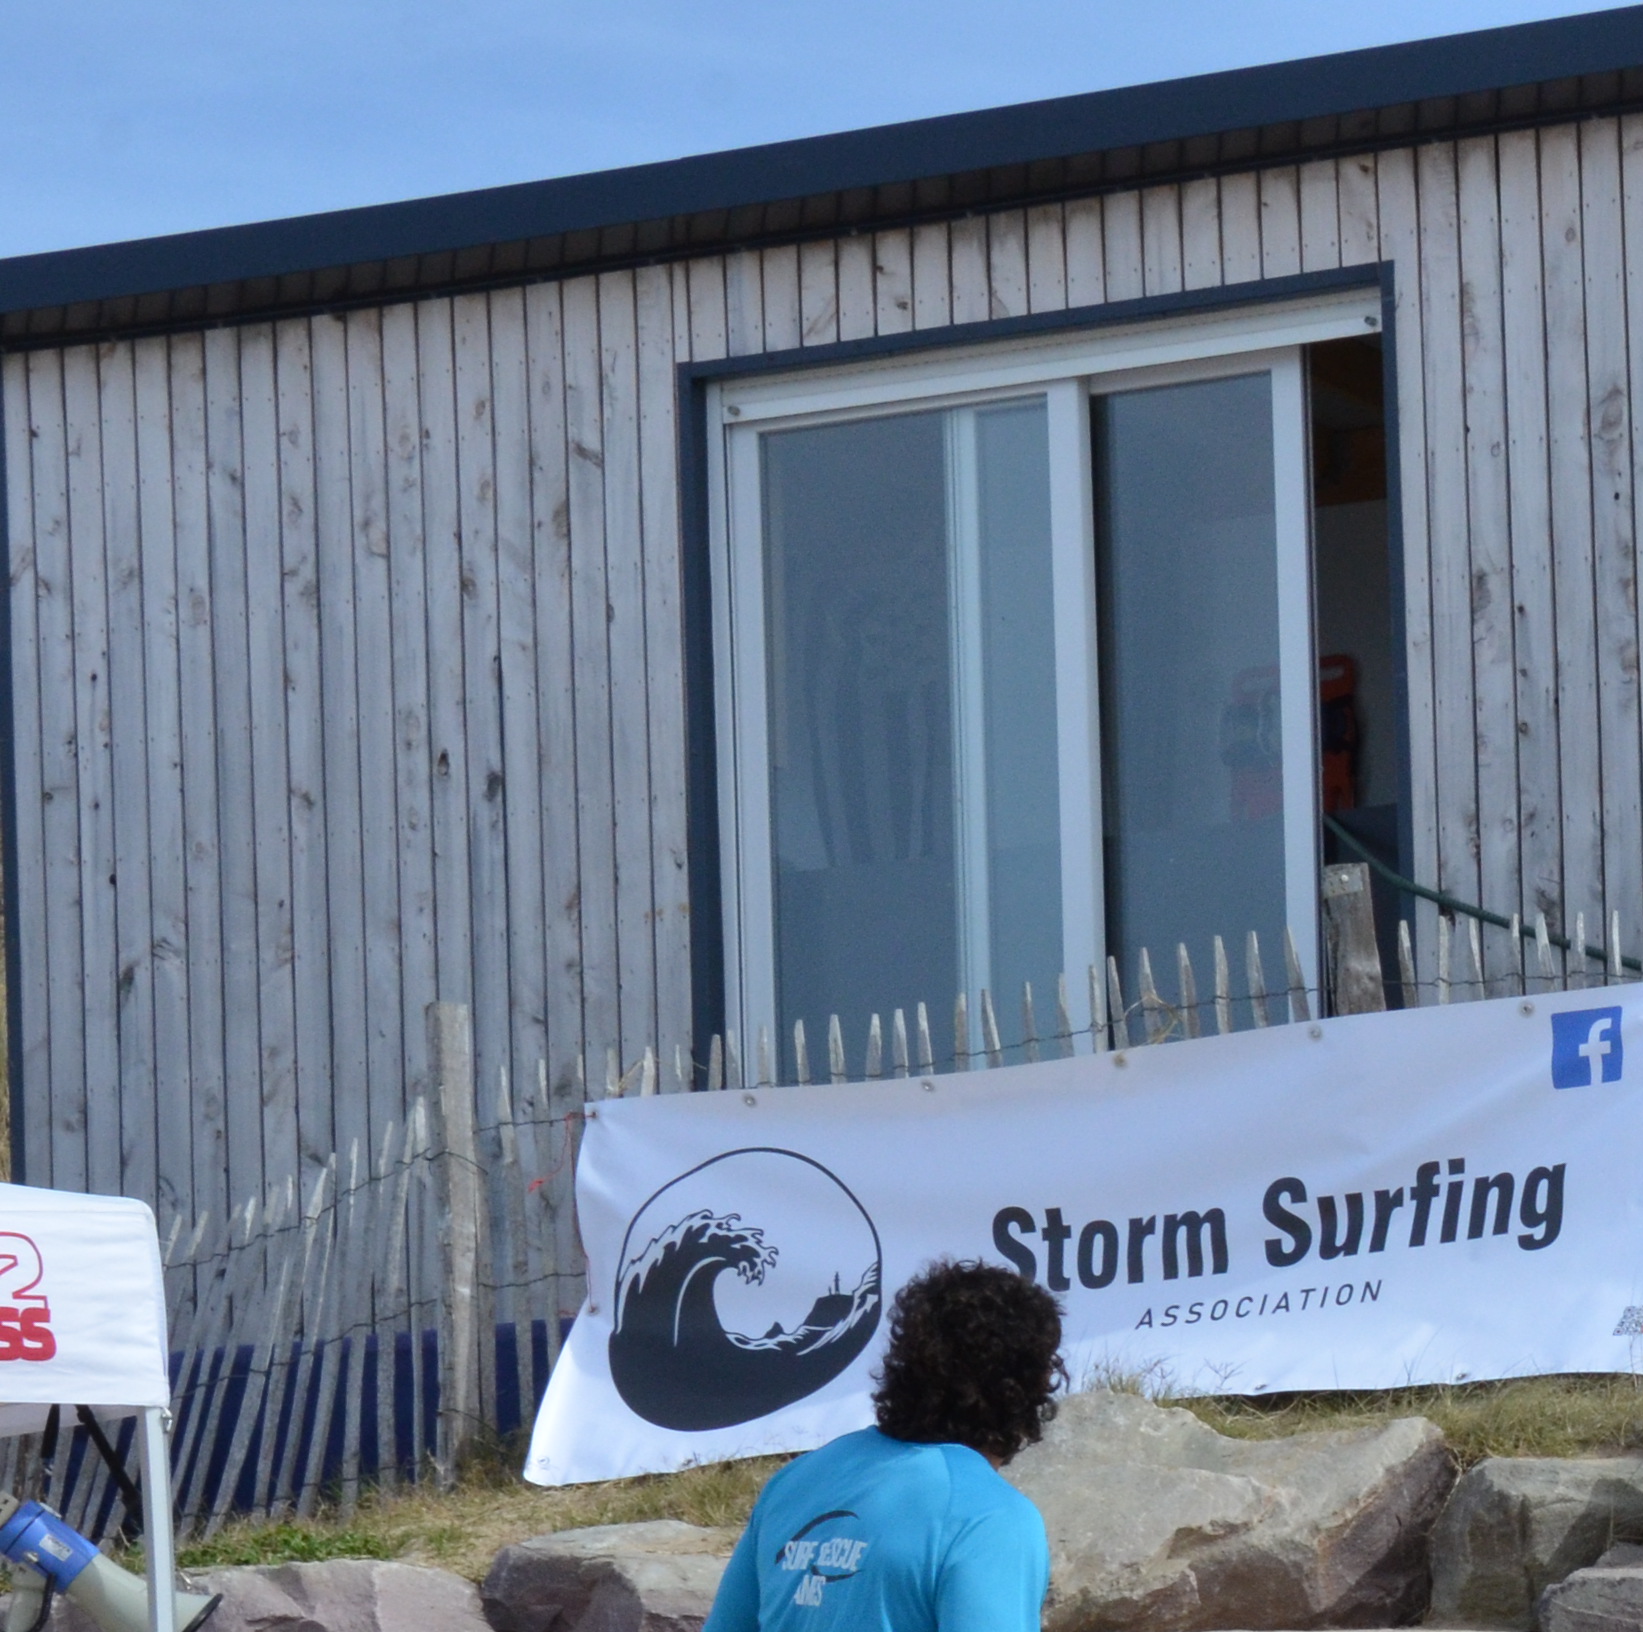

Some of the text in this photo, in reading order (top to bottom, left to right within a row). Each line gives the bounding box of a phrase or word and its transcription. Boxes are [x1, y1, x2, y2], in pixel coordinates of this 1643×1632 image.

[992, 1157, 1567, 1291] Storm Surfing
[1135, 1279, 1383, 1330] ASSOCIATION
[0, 1306, 57, 1362] SS
